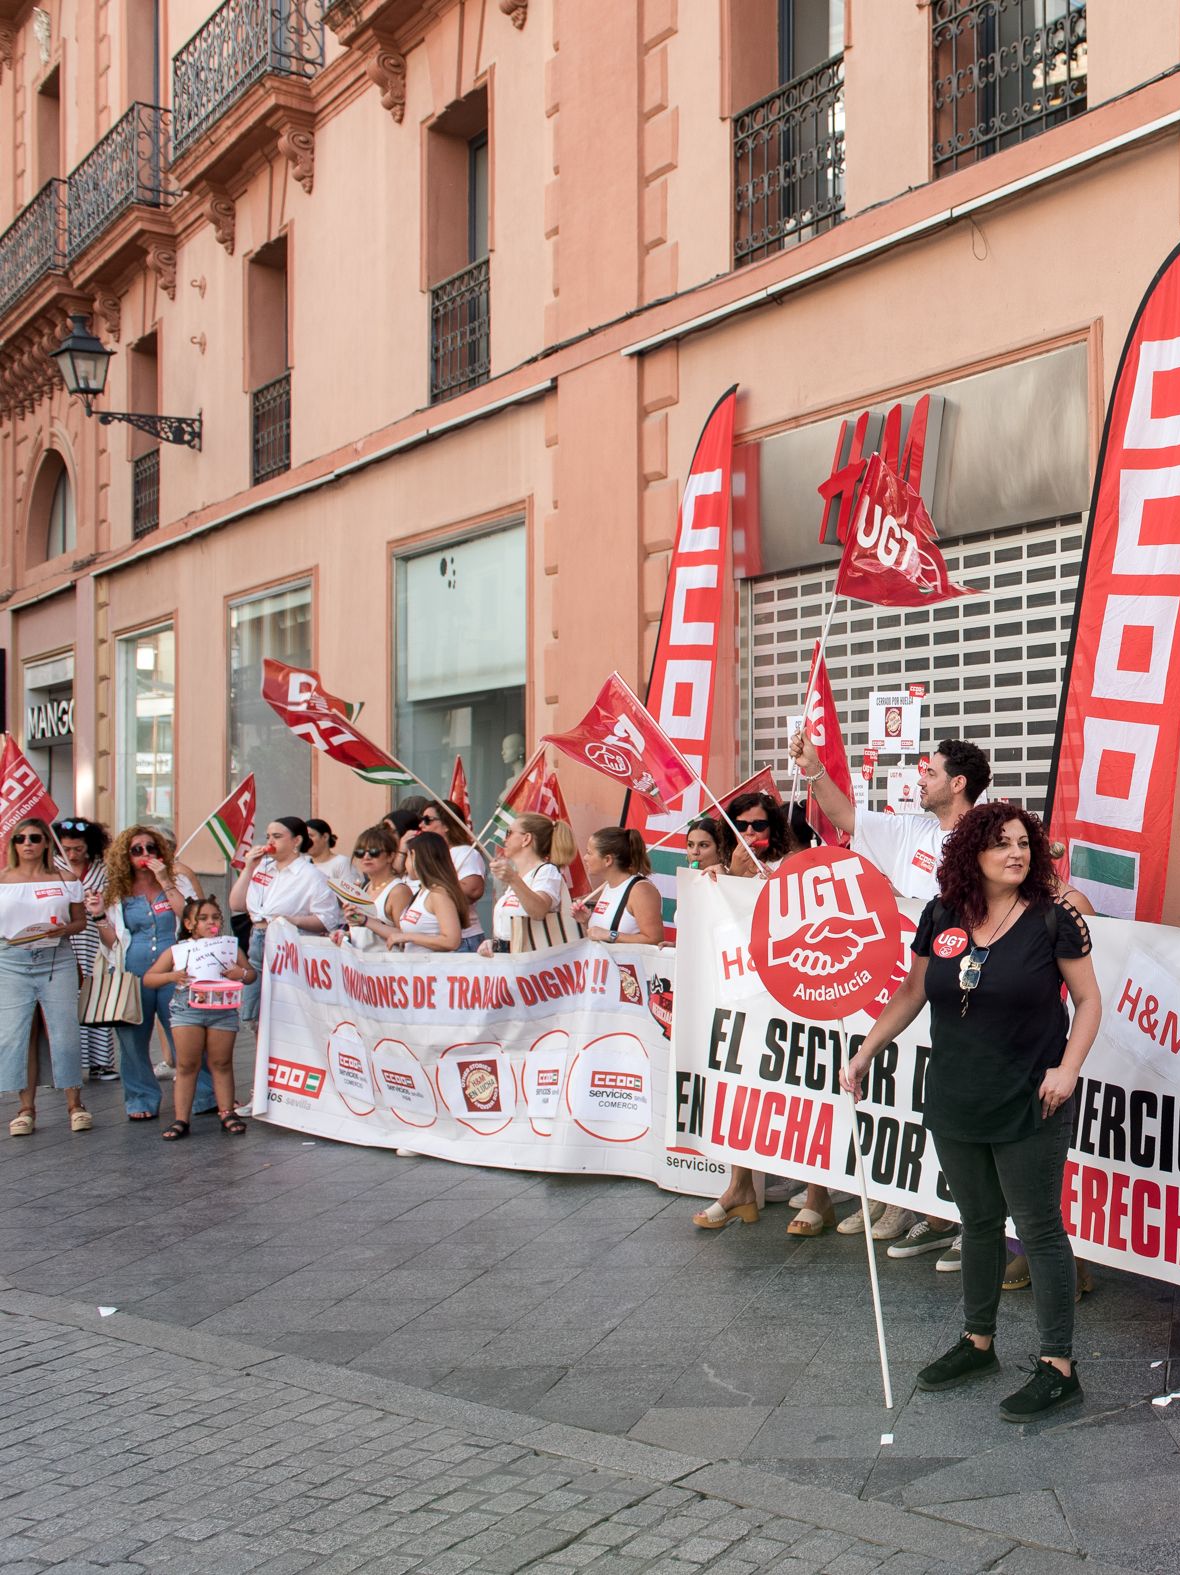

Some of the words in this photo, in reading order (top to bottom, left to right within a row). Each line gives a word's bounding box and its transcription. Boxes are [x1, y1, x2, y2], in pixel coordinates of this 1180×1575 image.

[817, 394, 930, 545] HM
[856, 496, 919, 571] UGT
[769, 857, 864, 938] UGT
[938, 933, 966, 948] UGT
[413, 976, 436, 1008] DE
[793, 968, 872, 1001] Andalucía
[708, 1007, 746, 1075] EL
[269, 1063, 305, 1088] COO
[595, 1074, 633, 1088] CCOO
[589, 1090, 632, 1100] servicios
[599, 1101, 638, 1110] COMERCIO
[676, 1071, 706, 1137] EN
[711, 1081, 834, 1171] LUCHA
[845, 1109, 926, 1194] POR
[666, 1155, 726, 1175] servicios
